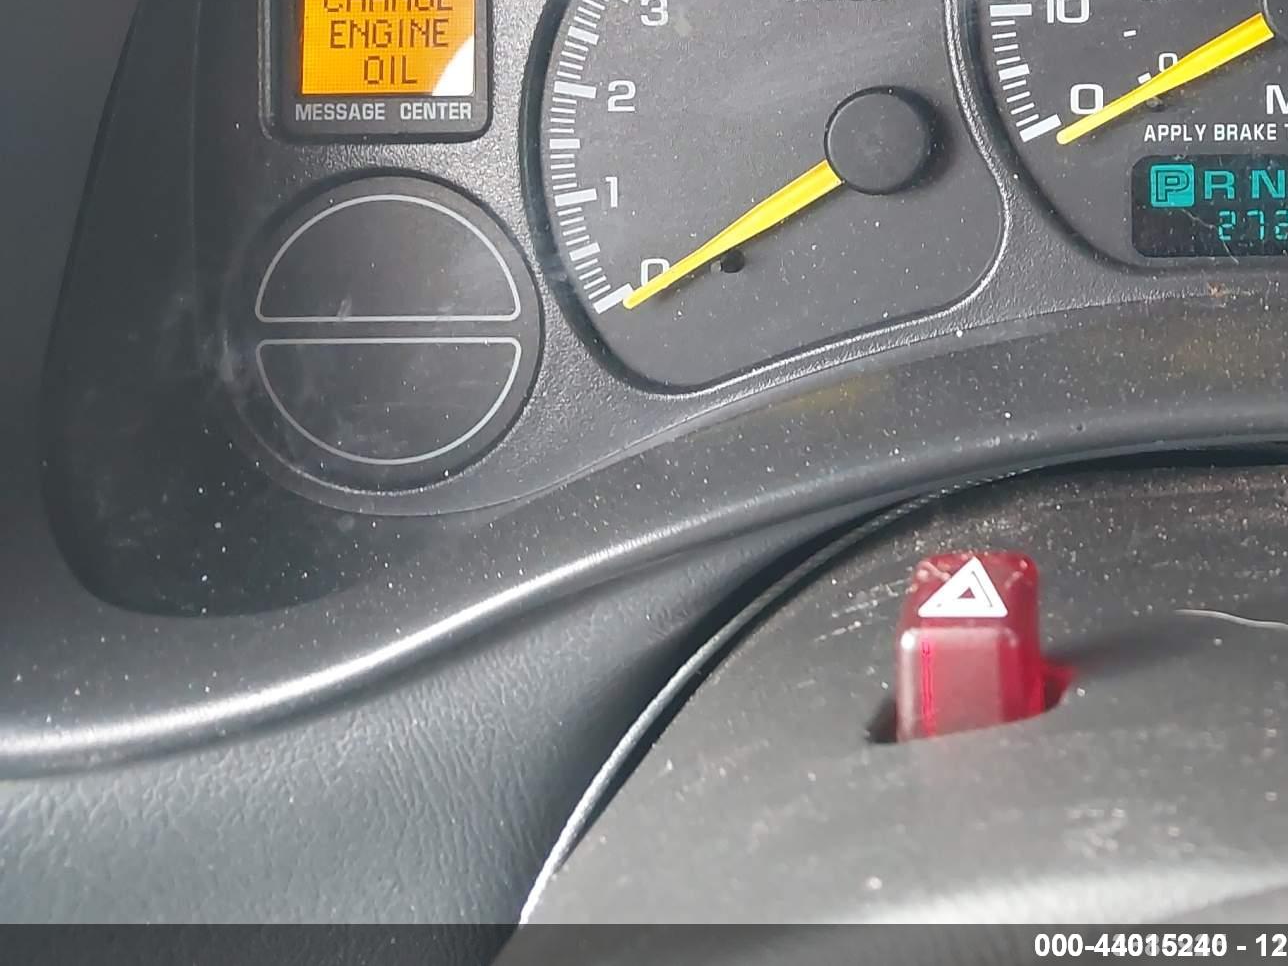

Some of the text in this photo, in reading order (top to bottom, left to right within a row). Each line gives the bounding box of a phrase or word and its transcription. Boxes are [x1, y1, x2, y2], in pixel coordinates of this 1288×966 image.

[330, 18, 450, 49] ENGINE
[363, 55, 418, 86] OIL
[1158, 52, 1179, 74] 0
[295, 101, 473, 121] MESSAGE CENTER
[606, 80, 637, 113] 2
[1070, 83, 1104, 115] 0
[1143, 123, 1207, 143] APPLY
[1213, 123, 1277, 142] BRAKE
[604, 176, 619, 207] 1
[1153, 166, 1192, 205] P
[1204, 170, 1236, 201] R
[1252, 169, 1287, 199] N
[640, 257, 670, 287] 0
